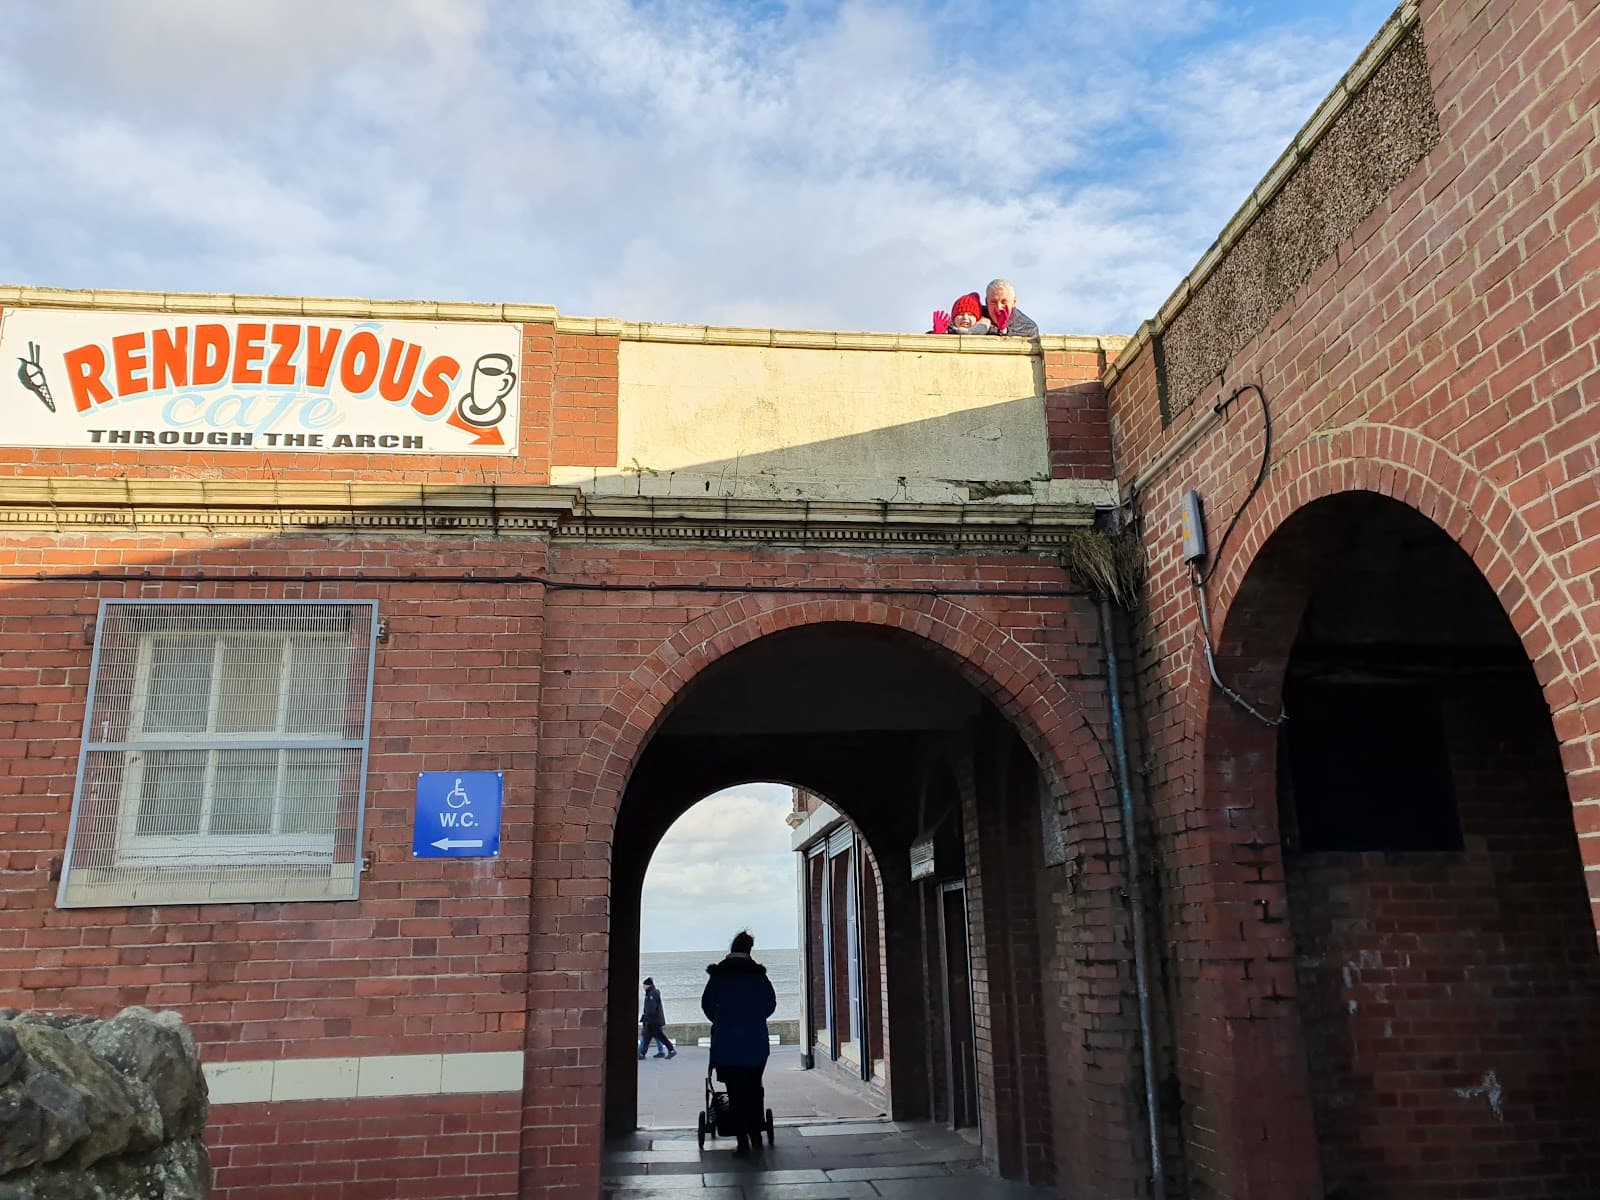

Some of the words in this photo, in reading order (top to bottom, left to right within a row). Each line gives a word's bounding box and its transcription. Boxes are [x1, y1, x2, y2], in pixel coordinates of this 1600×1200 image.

[63, 323, 462, 418] RENDEZVOUS
[86, 429, 253, 446] THROUGH
[263, 432, 324, 448] THE
[332, 433, 424, 449] ARCH
[439, 812, 479, 828] W.C.
